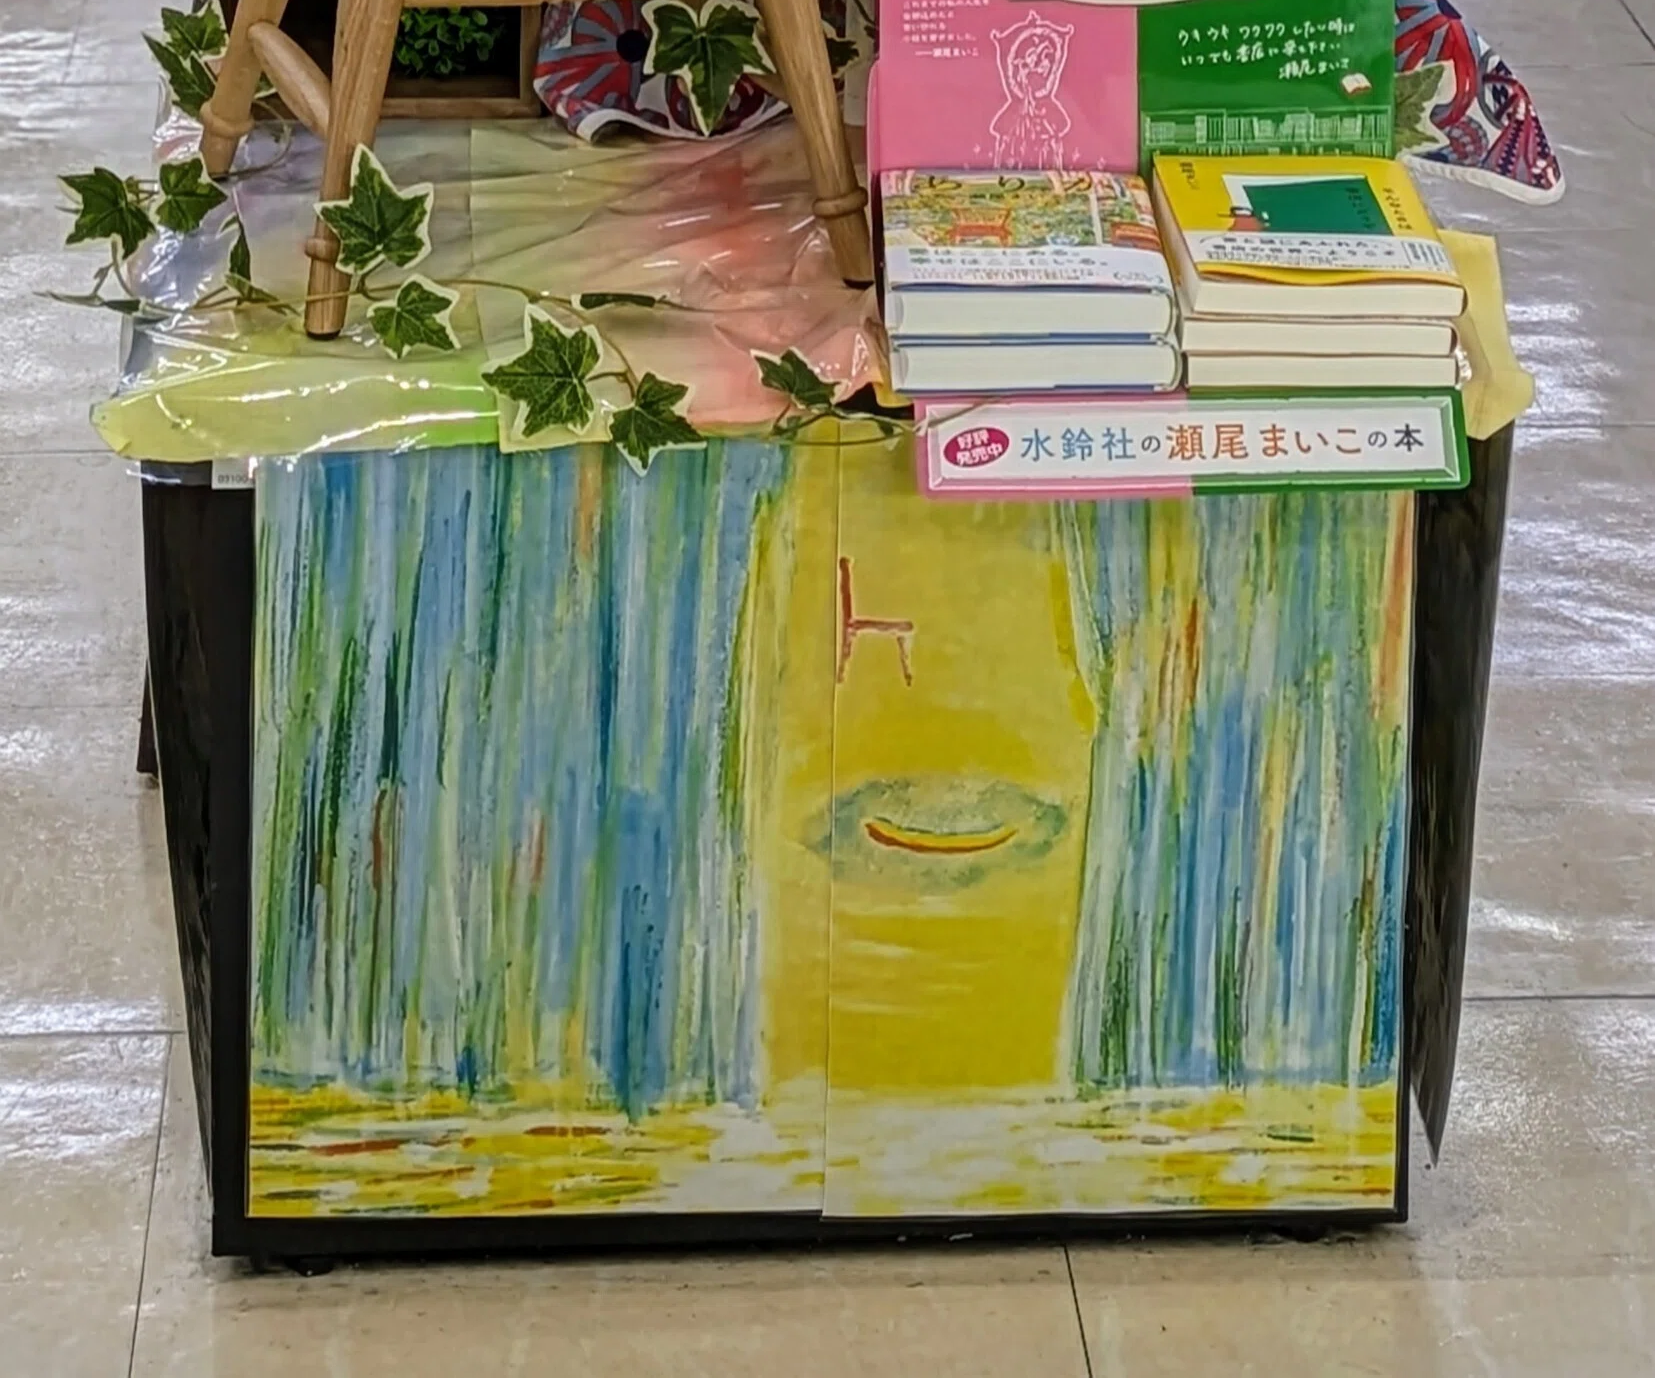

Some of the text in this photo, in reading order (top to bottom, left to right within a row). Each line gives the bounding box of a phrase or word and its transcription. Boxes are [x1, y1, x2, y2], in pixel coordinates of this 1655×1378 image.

[1020, 423, 1425, 463] 水鈴社の瀬尾まいこの本
